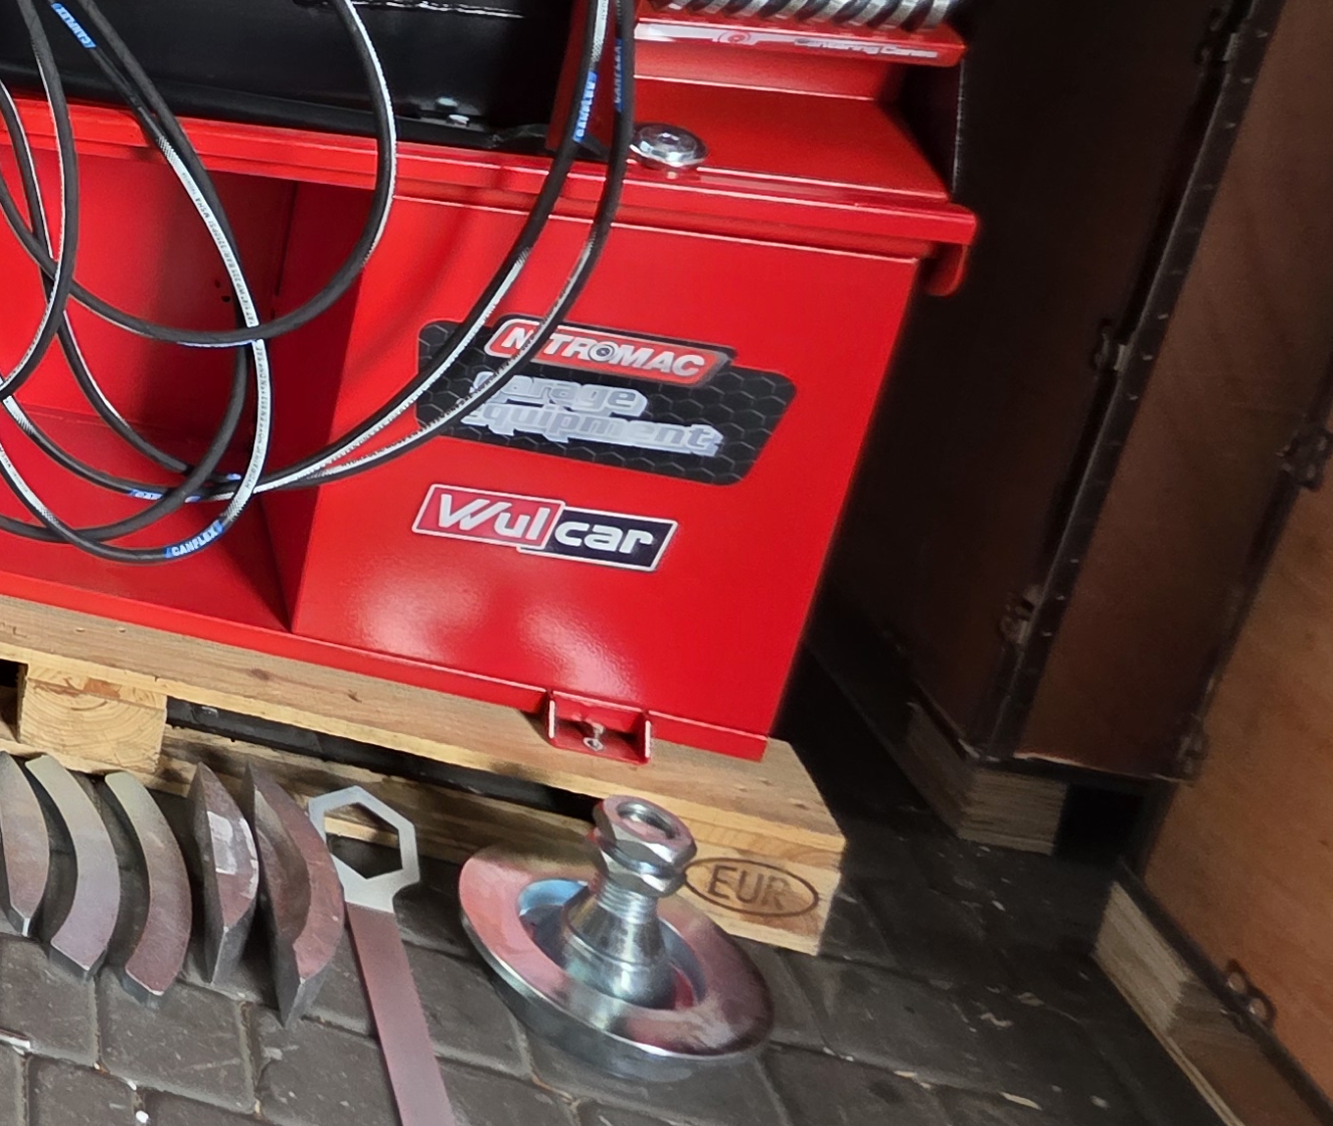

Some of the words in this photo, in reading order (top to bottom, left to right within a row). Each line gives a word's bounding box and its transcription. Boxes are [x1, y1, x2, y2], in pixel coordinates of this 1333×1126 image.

[574, 79, 596, 138] CANFLEX
[194, 196, 211, 219] MSHA
[500, 327, 705, 376] NTROMAC
[169, 525, 218, 558] CANFLEX
[439, 493, 653, 555] Wulcar
[708, 863, 791, 911] EUR
